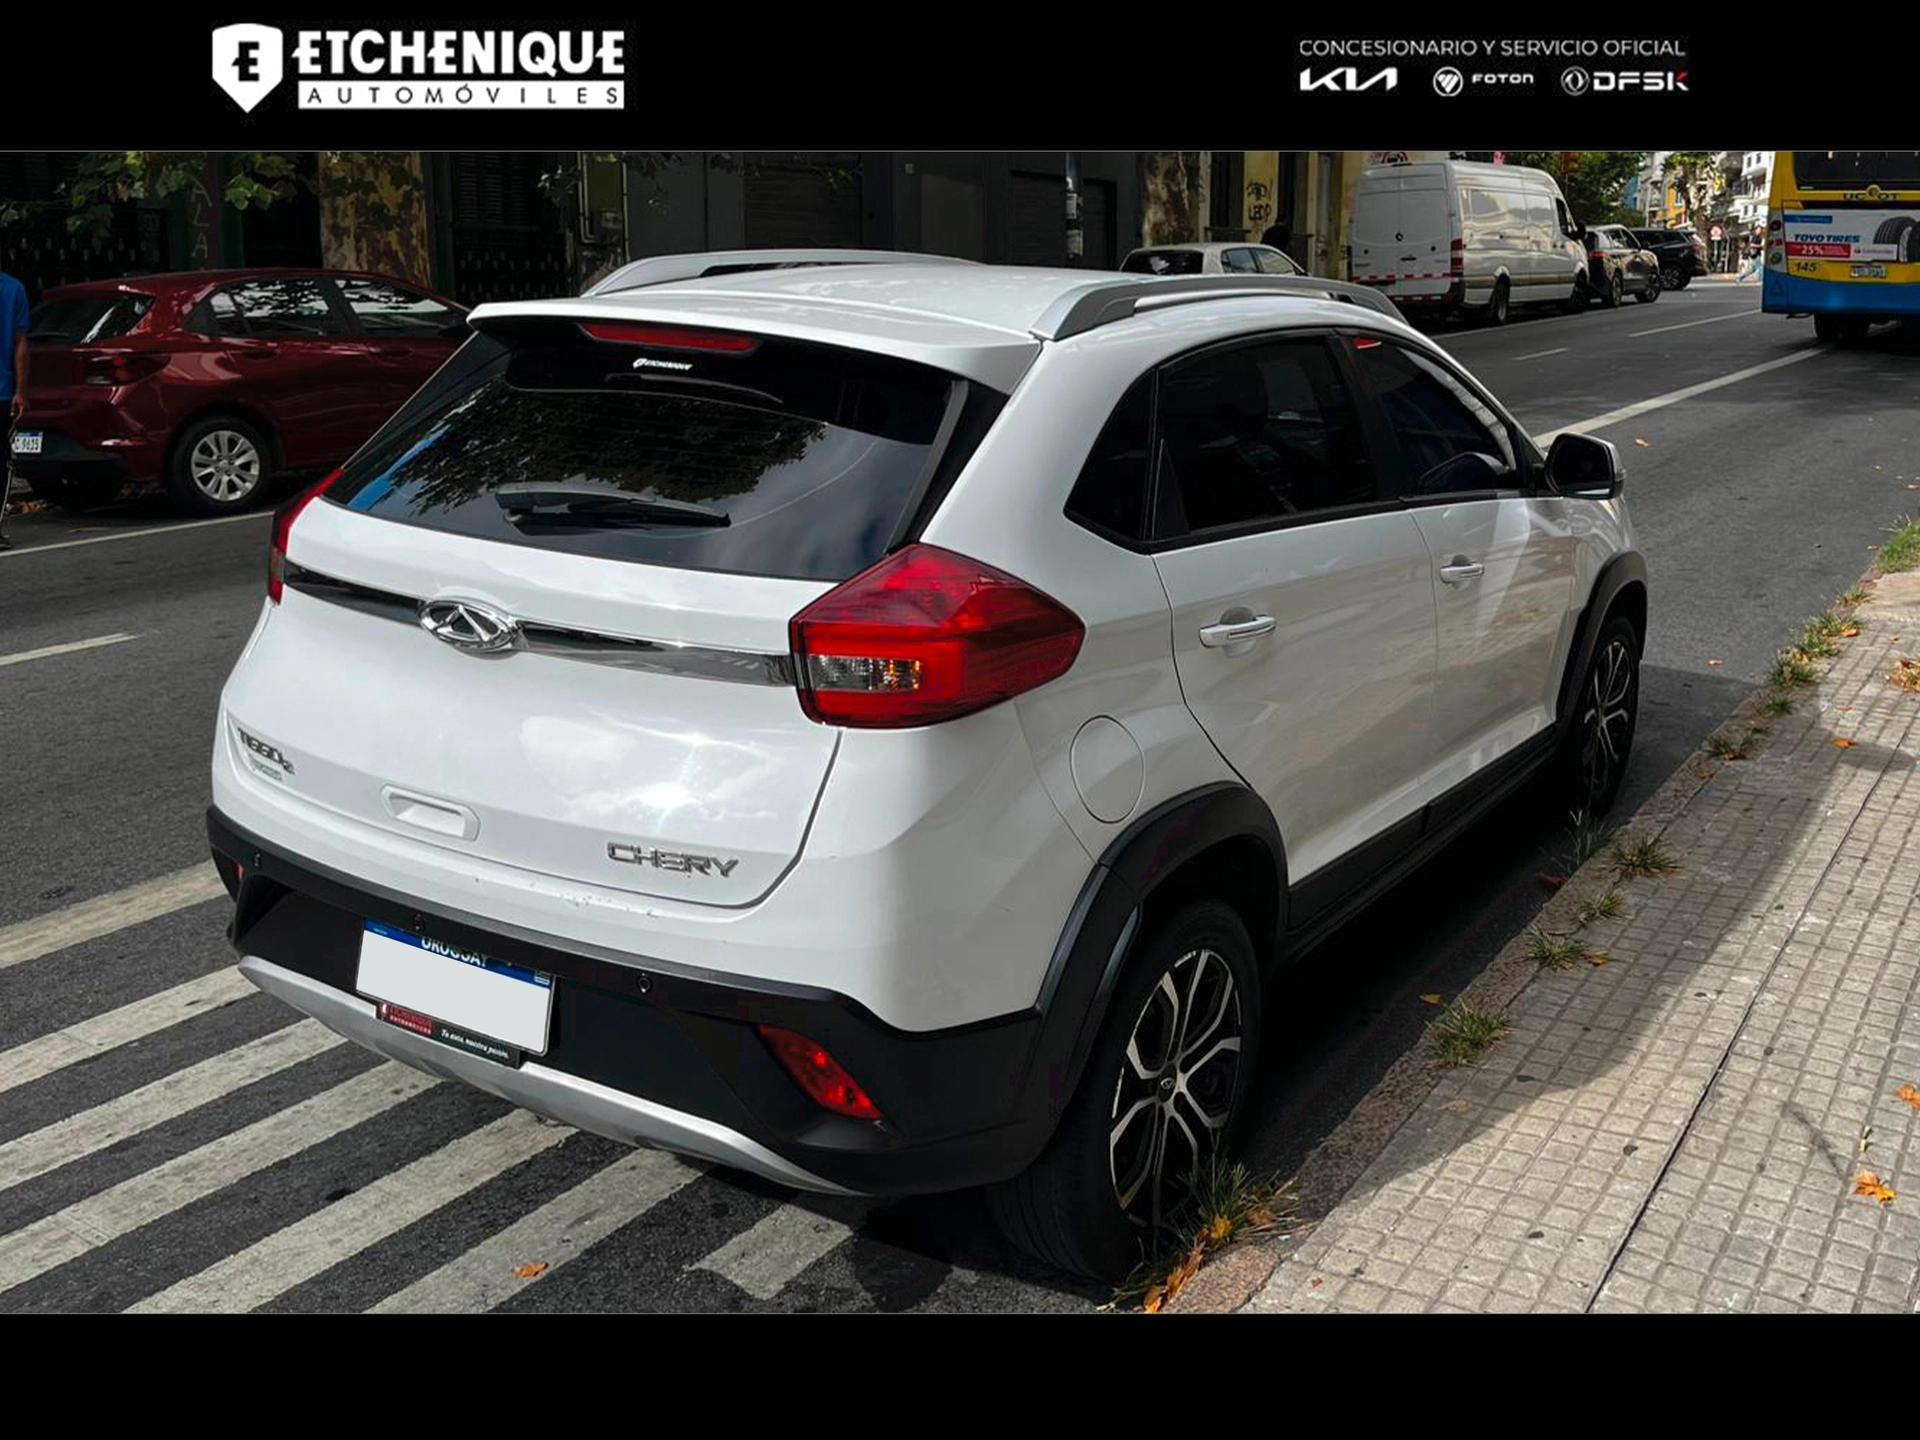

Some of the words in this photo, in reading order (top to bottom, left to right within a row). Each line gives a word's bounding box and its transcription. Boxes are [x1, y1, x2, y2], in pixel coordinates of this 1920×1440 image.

[1794, 233, 1825, 243] TOYO
[1824, 234, 1861, 243] TIRES
[1801, 244, 1824, 255] 25%
[1796, 261, 1818, 273] 145
[607, 842, 740, 878] CHERY
